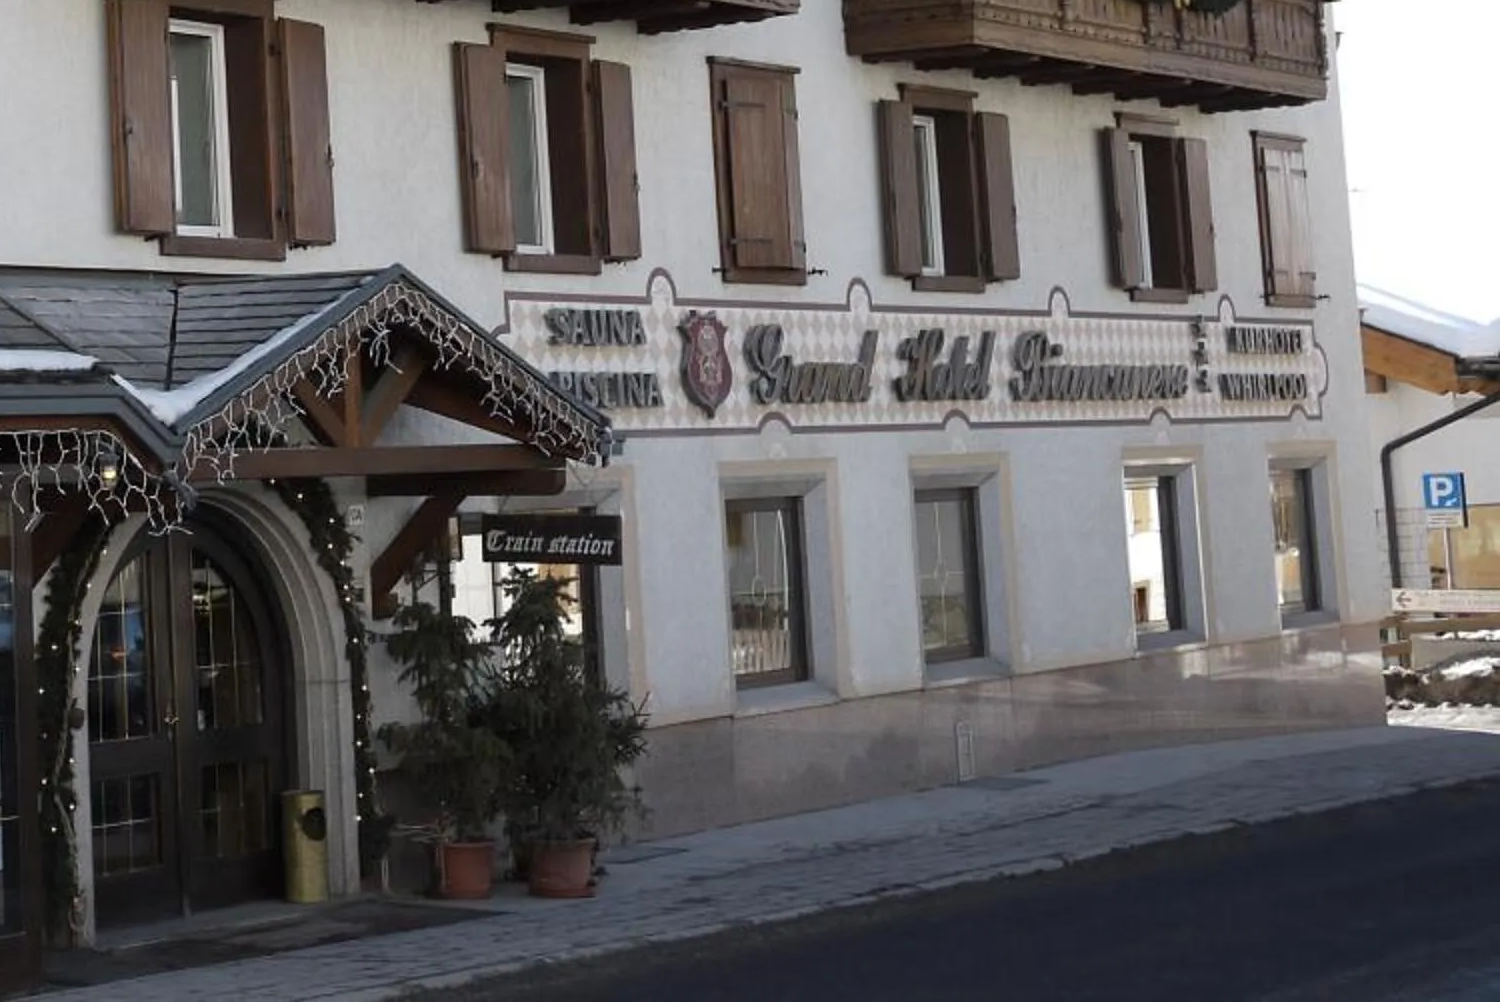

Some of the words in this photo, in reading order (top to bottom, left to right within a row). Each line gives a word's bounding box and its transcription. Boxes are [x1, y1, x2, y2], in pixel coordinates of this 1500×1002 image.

[544, 308, 647, 347] SAUNA
[742, 324, 879, 404] Grand
[891, 328, 996, 402] Hotel
[1007, 331, 1189, 402] Biancaneve
[548, 371, 664, 409] PISCINA
[1429, 477, 1453, 507] P
[486, 529, 544, 553] Train
[547, 533, 615, 556] station
